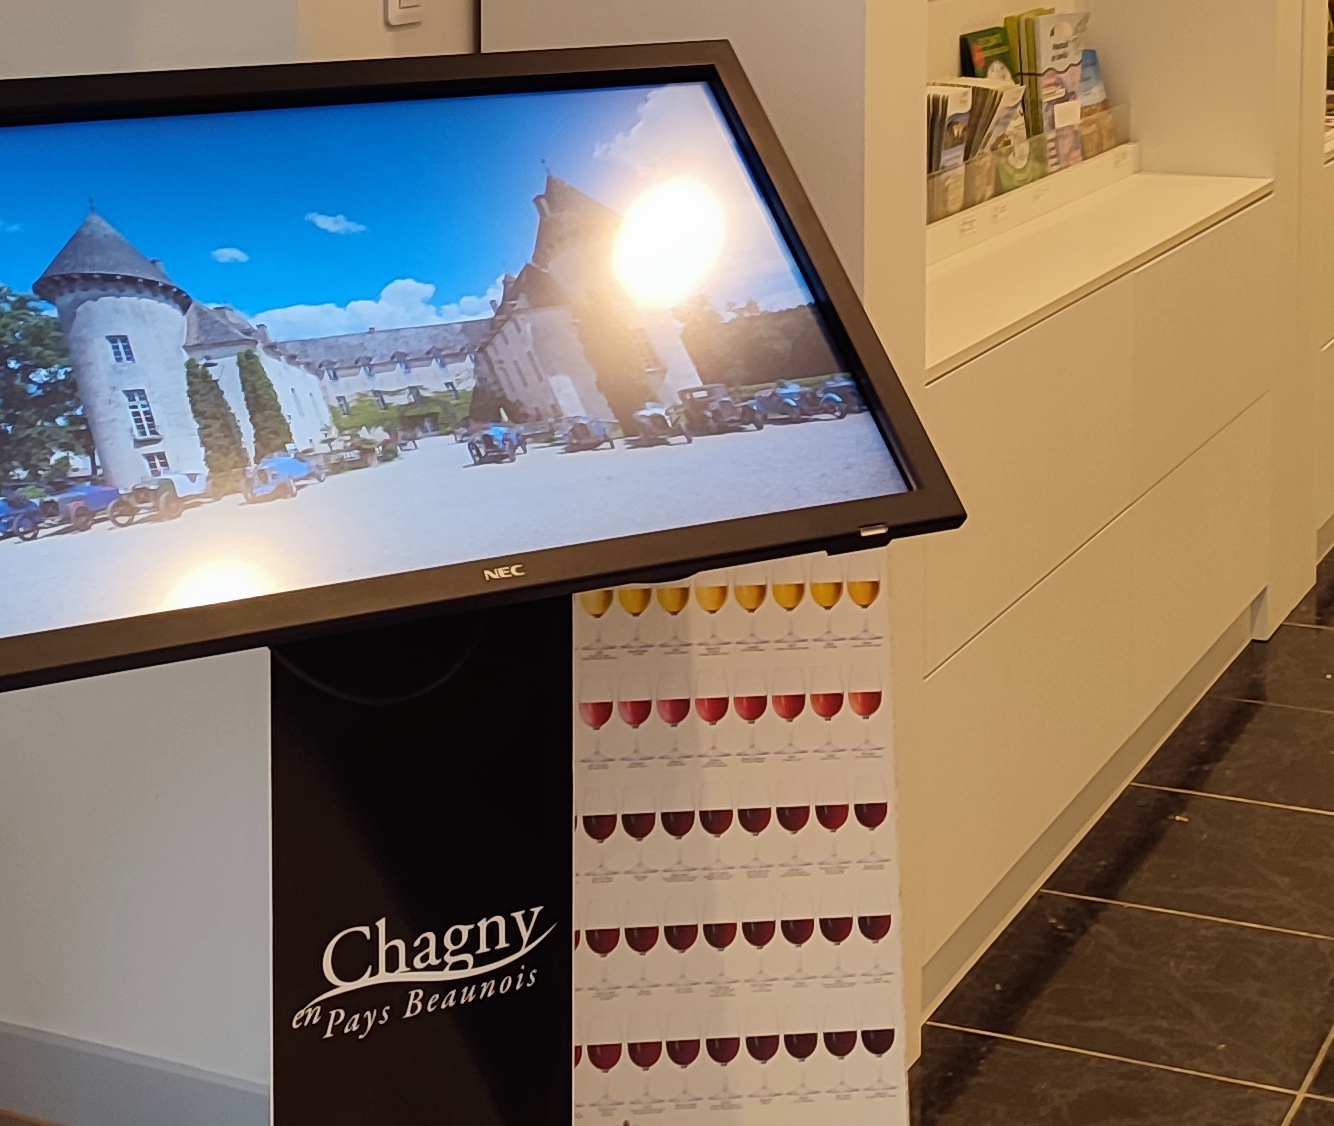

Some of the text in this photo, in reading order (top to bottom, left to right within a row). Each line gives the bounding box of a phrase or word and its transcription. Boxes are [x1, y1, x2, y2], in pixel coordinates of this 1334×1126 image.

[483, 564, 526, 581] NEC
[322, 905, 544, 987] Chagny
[292, 1004, 322, 1030] en
[322, 1005, 391, 1040] Pays
[402, 964, 538, 1019] Beaunois
